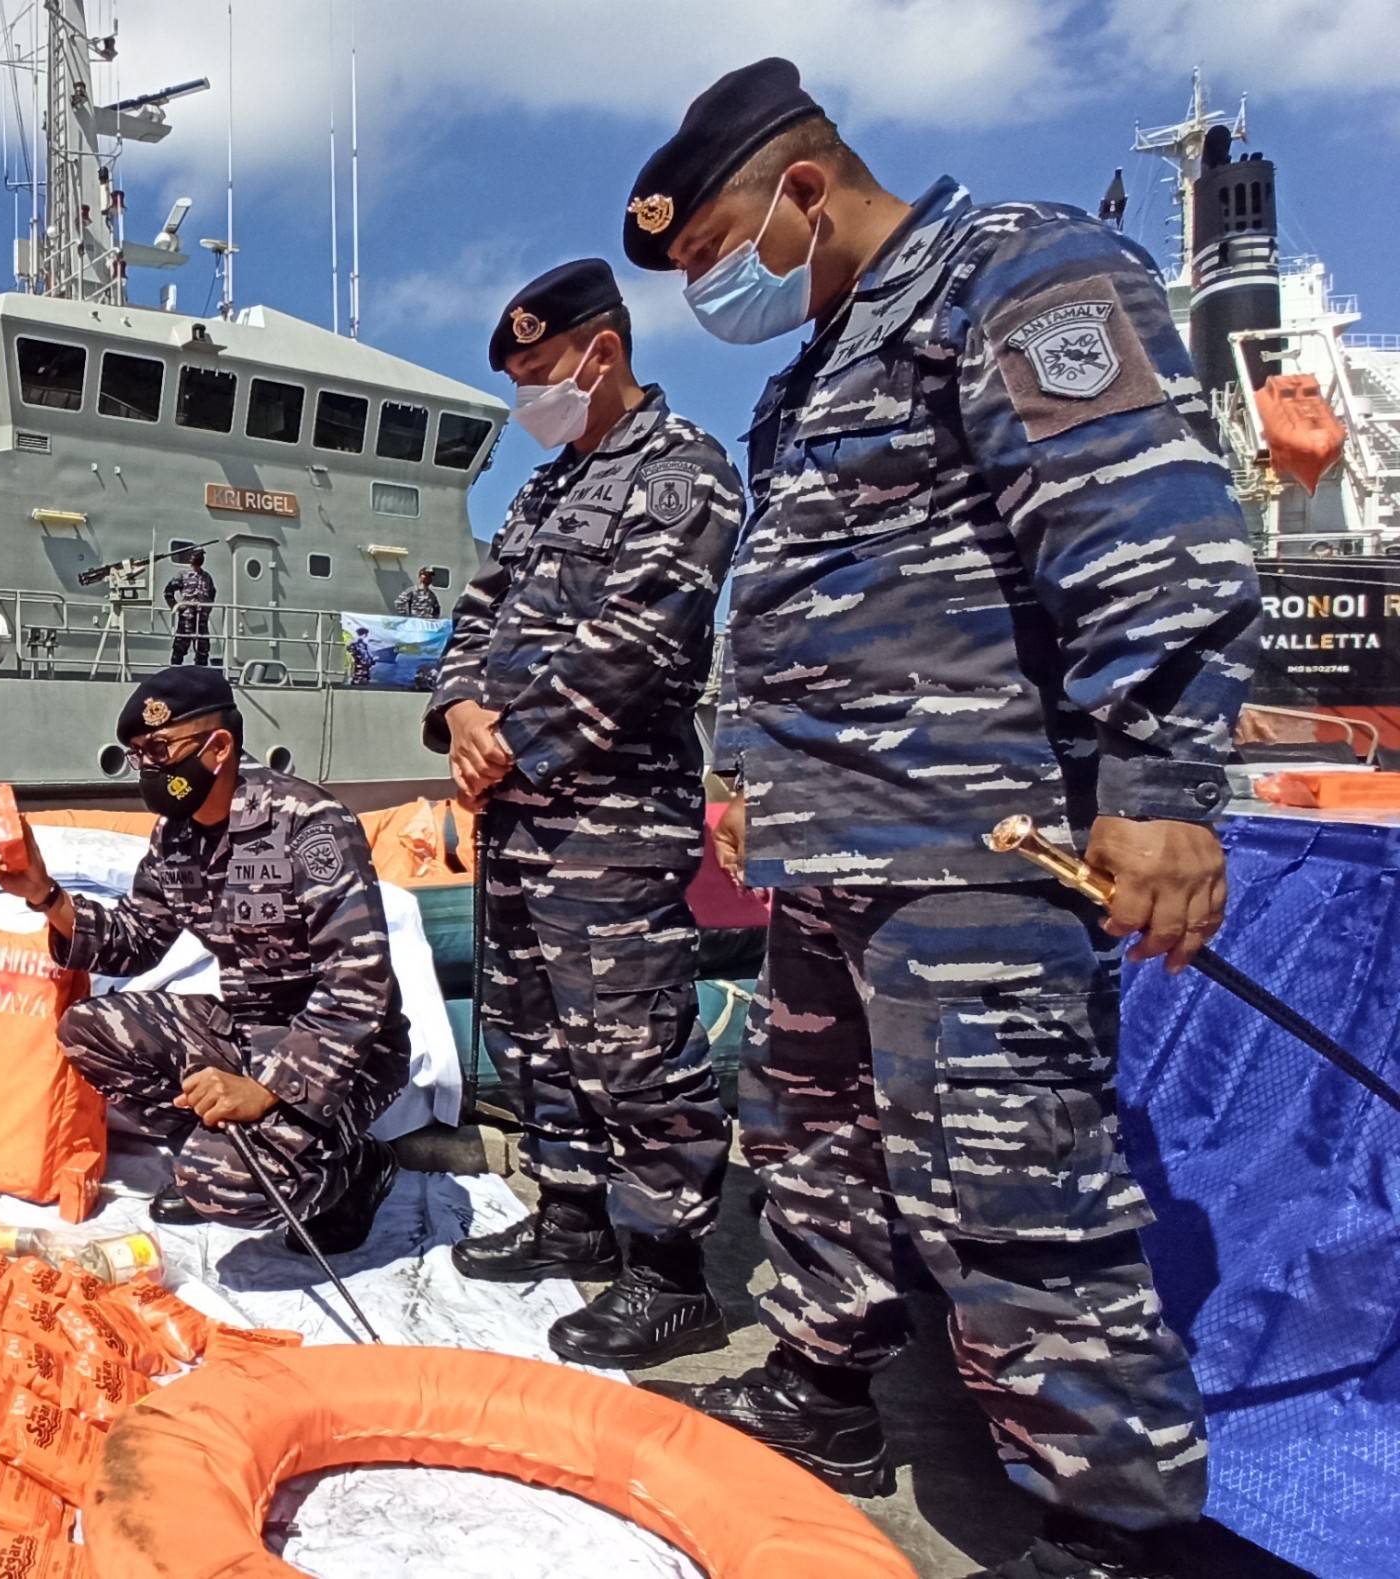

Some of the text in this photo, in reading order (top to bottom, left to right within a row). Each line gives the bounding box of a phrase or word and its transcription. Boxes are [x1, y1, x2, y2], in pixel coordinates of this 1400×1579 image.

[1010, 304, 1107, 344] LANTAMAL V
[213, 488, 294, 513] KRI RIGEL
[569, 484, 613, 503] TNI AL
[1260, 633, 1380, 651] VALLETTA
[235, 864, 282, 880] TNI AL
